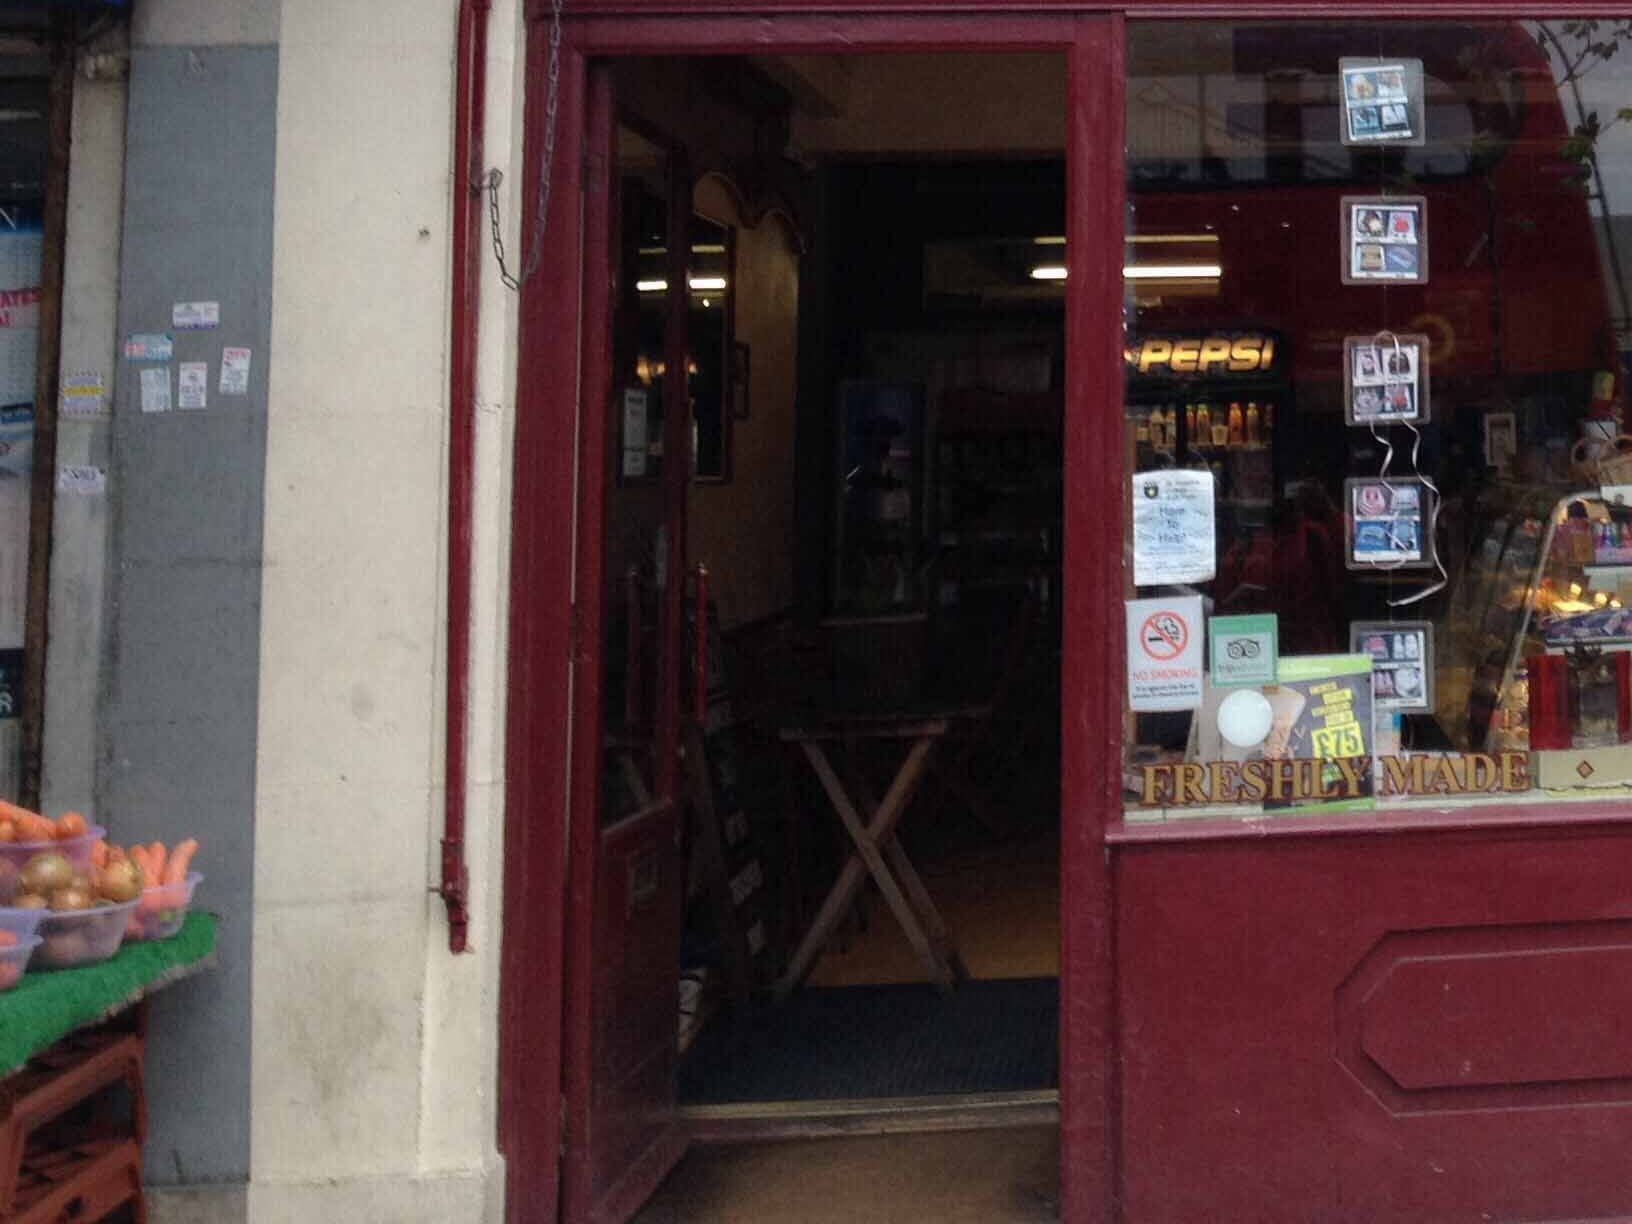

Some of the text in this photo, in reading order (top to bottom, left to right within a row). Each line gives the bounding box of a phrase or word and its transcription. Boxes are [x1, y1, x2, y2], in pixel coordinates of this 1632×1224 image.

[1139, 336, 1275, 373] PEPSI
[1315, 725, 1359, 756] £75
[1138, 751, 1533, 808] FRESHLY MADE
